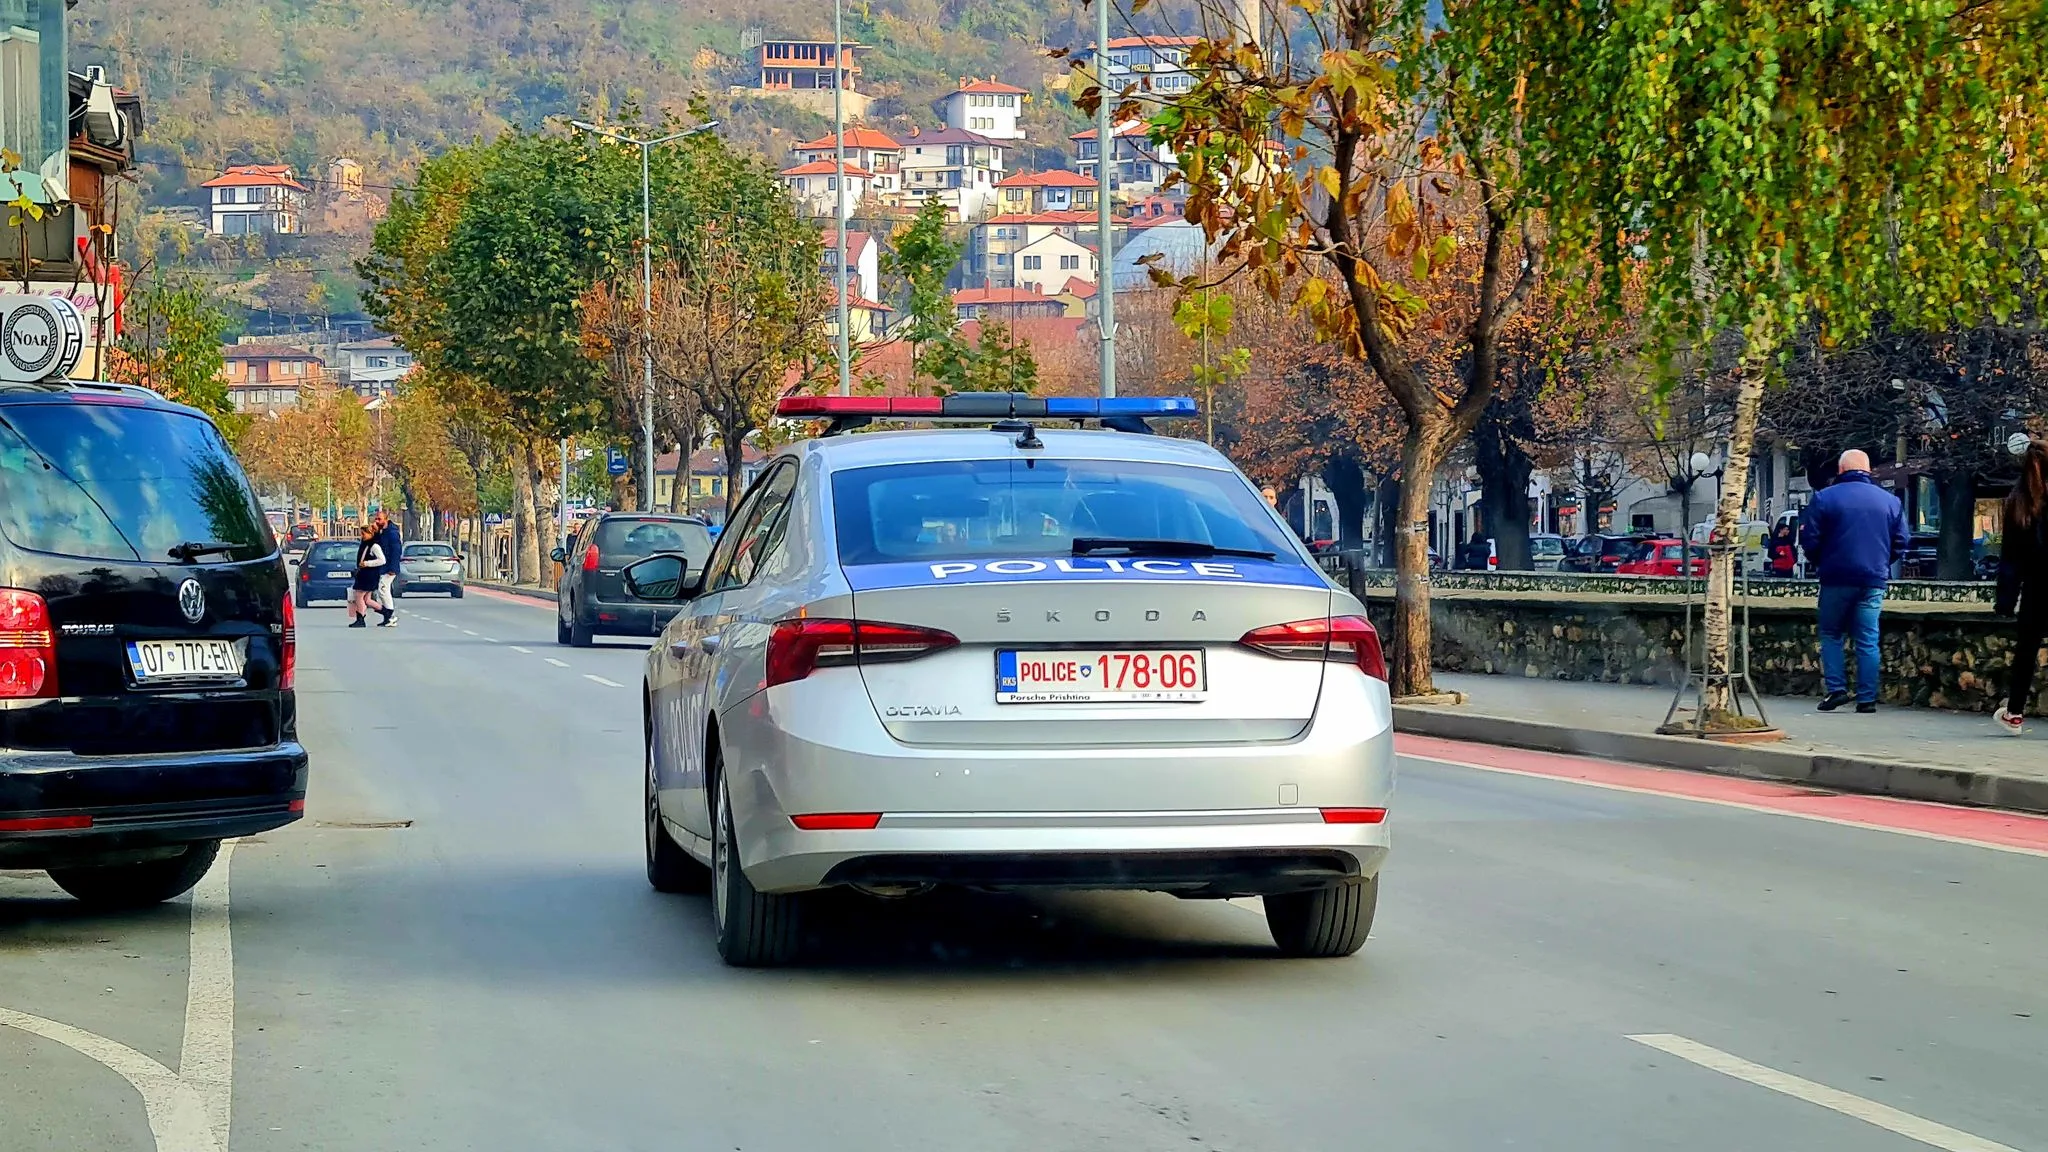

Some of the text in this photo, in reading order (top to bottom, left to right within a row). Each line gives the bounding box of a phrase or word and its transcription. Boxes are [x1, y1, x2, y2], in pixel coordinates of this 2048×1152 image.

[611, 450, 623, 463] P
[929, 559, 1244, 579] POLICE
[997, 608, 1207, 623] ŠKODA
[1021, 654, 1197, 688] POLICE 178-06
[886, 706, 962, 716] OCTAVIA
